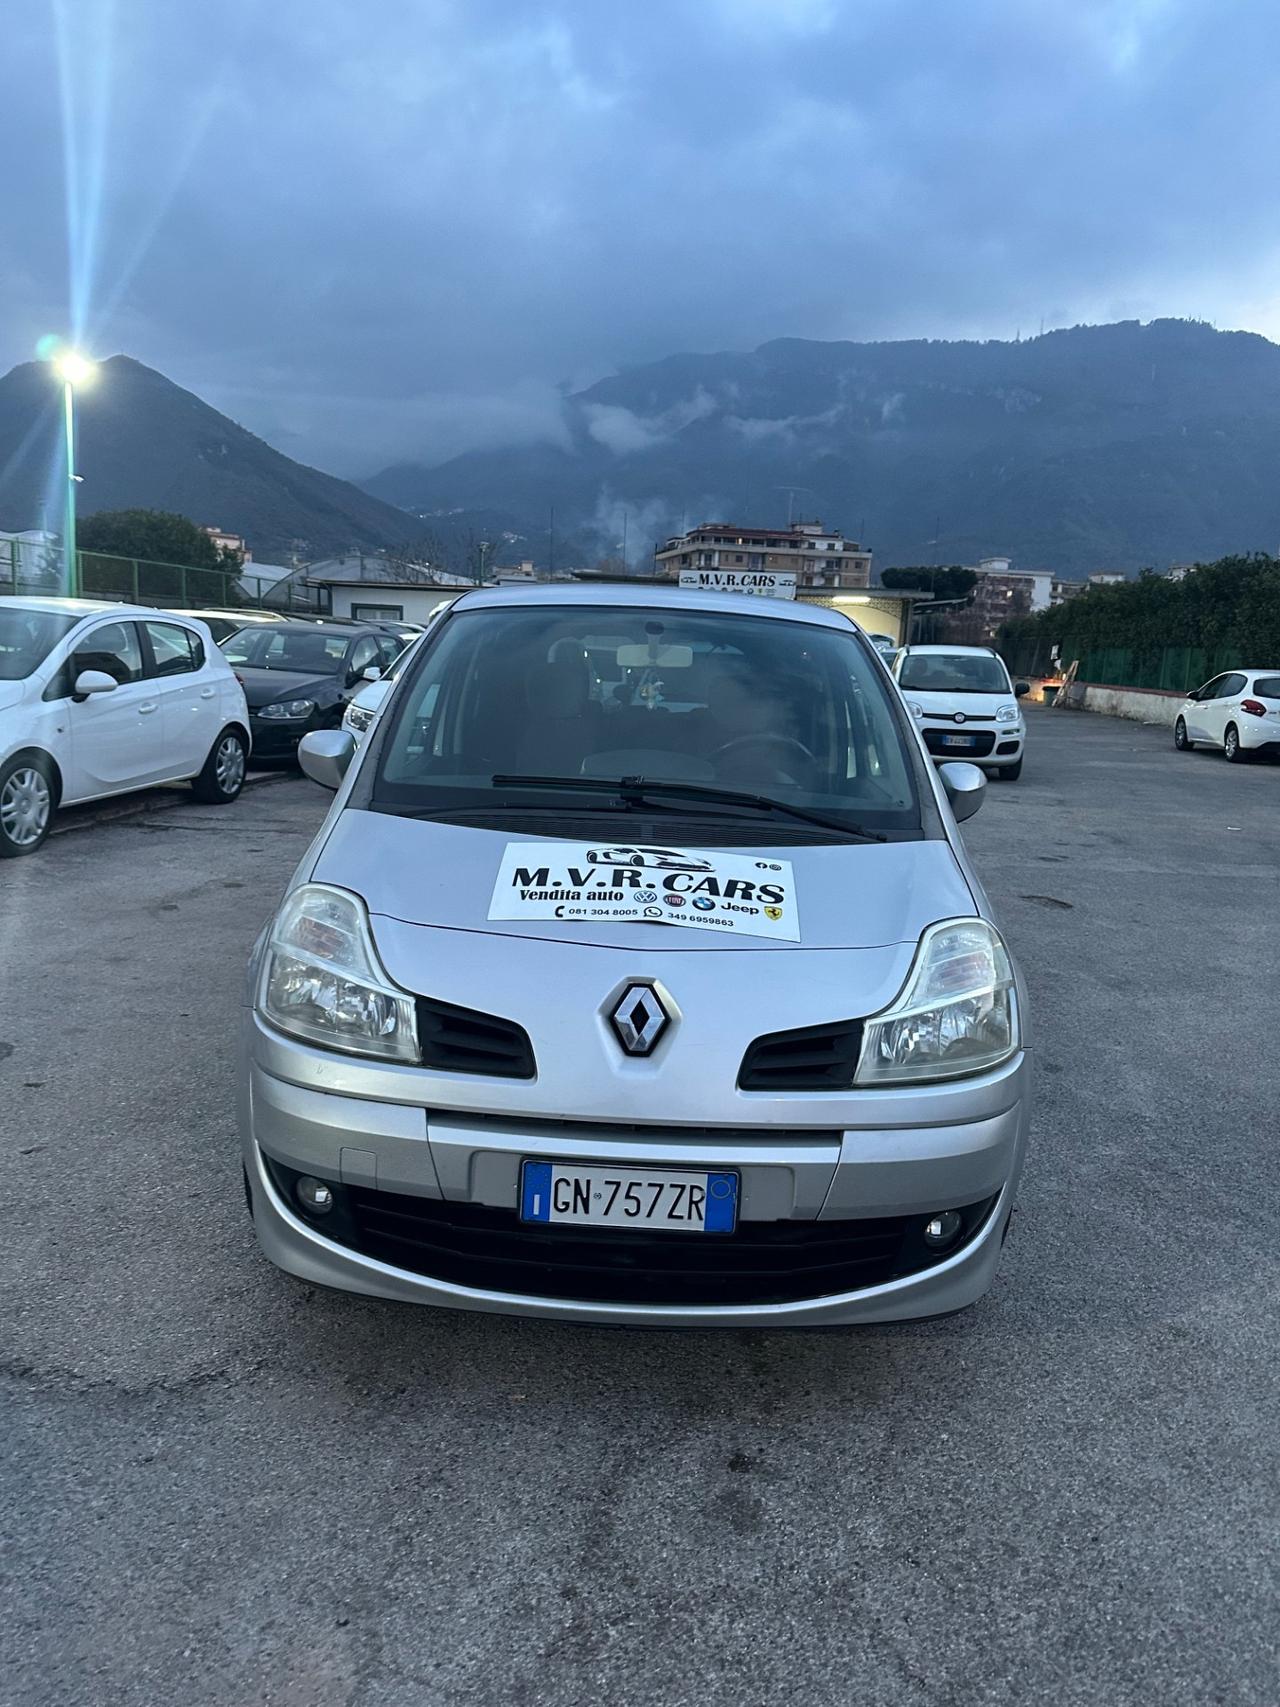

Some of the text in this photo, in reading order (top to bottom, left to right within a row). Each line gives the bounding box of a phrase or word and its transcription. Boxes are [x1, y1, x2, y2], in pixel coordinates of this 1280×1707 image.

[520, 889, 625, 901] Vendita auto
[568, 908, 639, 916] 081 304 8005
[720, 902, 760, 915] Jeep
[667, 912, 735, 927] 349 6959863
